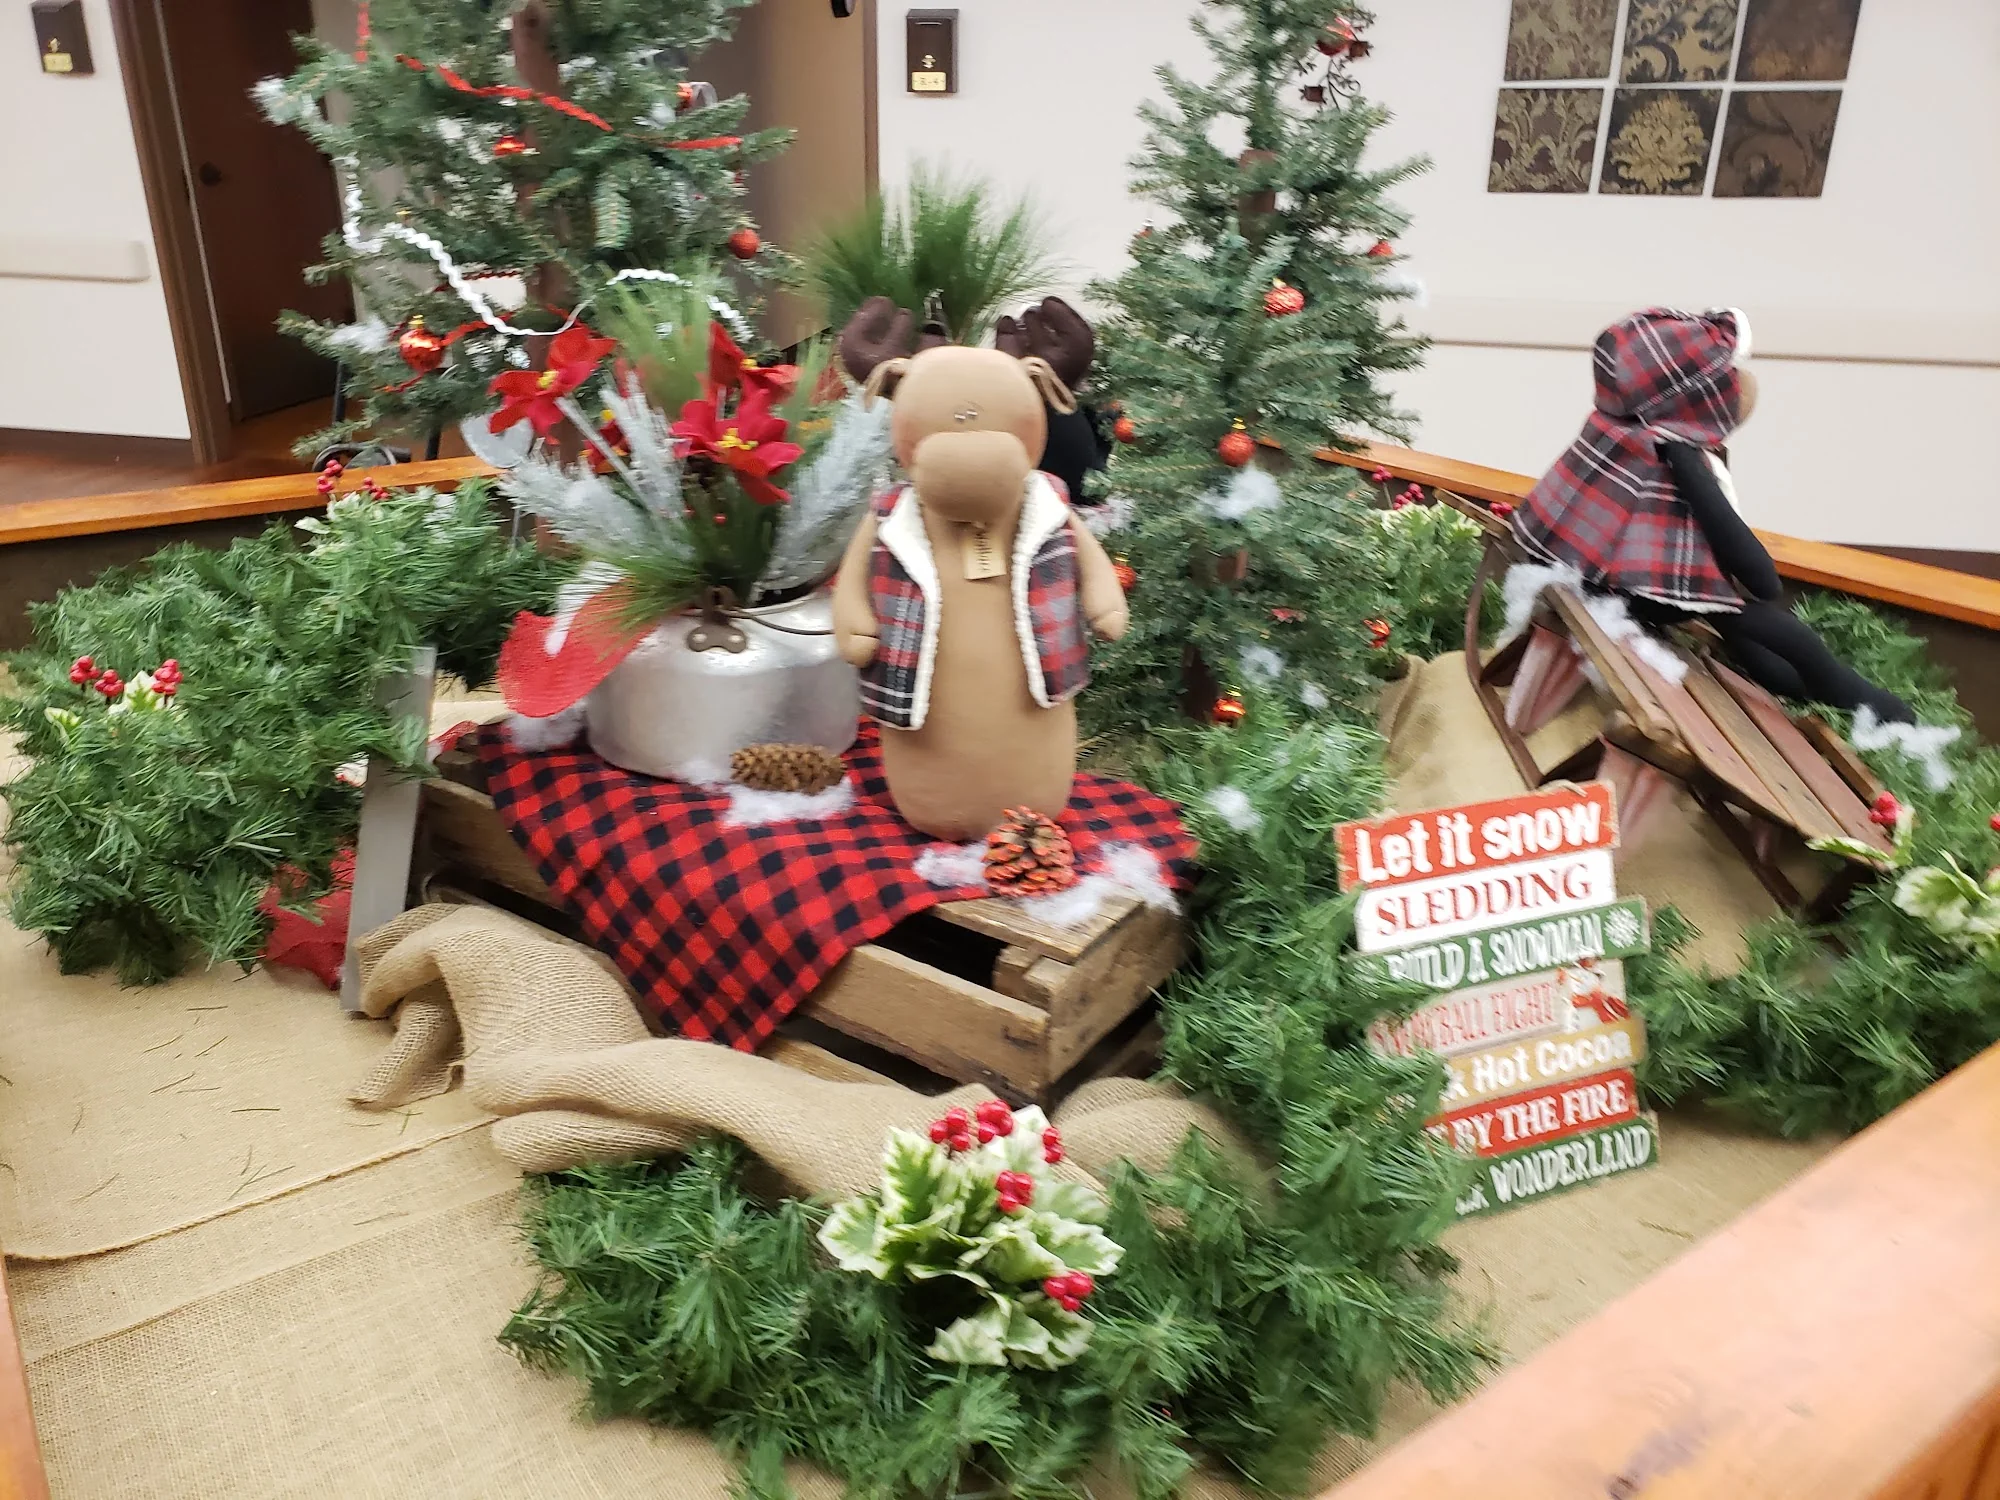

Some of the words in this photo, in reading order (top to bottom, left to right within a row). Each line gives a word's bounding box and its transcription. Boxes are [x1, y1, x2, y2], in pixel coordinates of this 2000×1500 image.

[1354, 819, 1433, 883] Let
[1437, 811, 1476, 868] it
[1480, 801, 1601, 860] snow
[1375, 863, 1592, 935] SLEDDING
[1467, 936, 1489, 984] A
[1489, 913, 1605, 977] SNOWMAN
[1489, 982, 1555, 1033] FIGHT
[1471, 1046, 1531, 1093] Hot
[1536, 1031, 1633, 1077] Cocoa
[1449, 1112, 1494, 1154] BY
[1495, 1096, 1561, 1142] THE
[1560, 1078, 1631, 1126] FIRE
[1488, 1125, 1651, 1203] WONDERLAND
